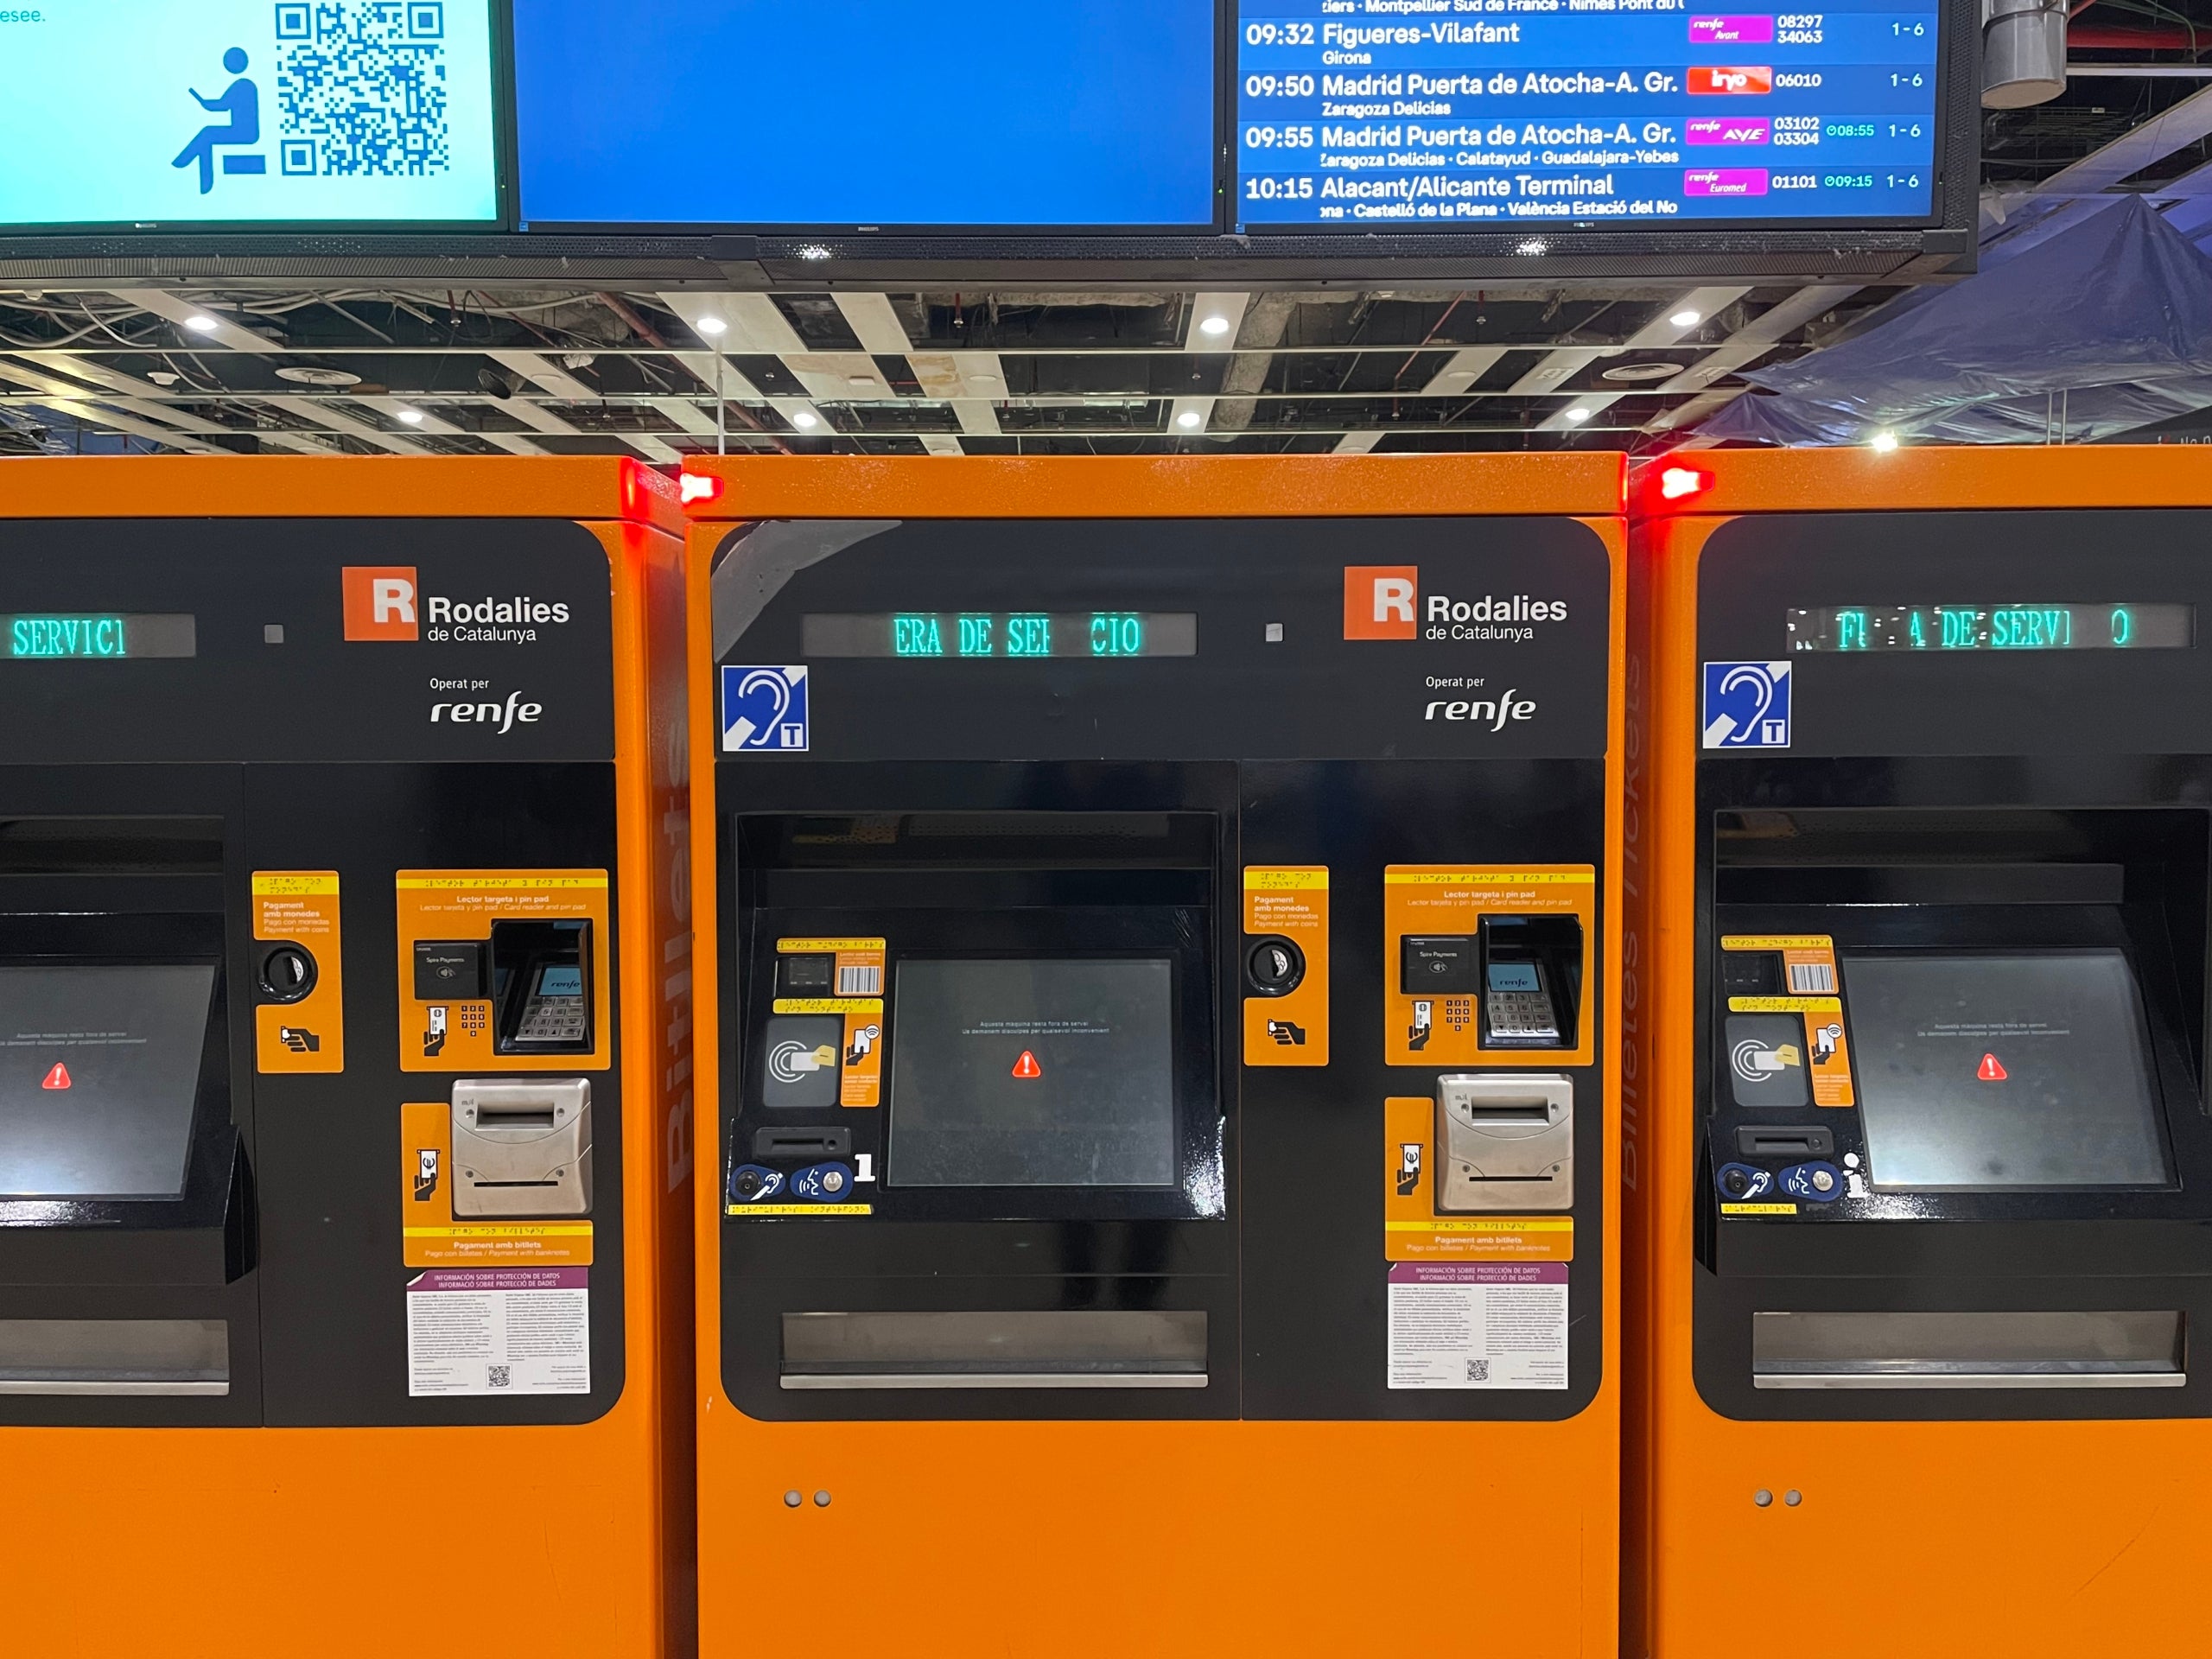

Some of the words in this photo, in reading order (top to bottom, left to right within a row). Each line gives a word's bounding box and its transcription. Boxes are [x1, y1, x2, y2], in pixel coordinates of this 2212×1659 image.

[1454, 0, 1483, 11] Sud
[1485, 0, 1505, 11] de
[1507, 0, 1558, 11] France
[1618, 0, 1654, 10] Pont
[1656, 0, 1675, 10] du
[1694, 18, 1724, 31] renfe
[1777, 15, 1823, 28] 08297
[1246, 23, 1314, 45] 09:32
[1323, 22, 1520, 49] Figueres-Vilafant
[1715, 31, 1739, 40] Avant
[1777, 30, 1823, 43] 34063
[1322, 51, 1372, 65] Girona
[1246, 75, 1314, 97] 09:50
[1322, 73, 1402, 96] Madrid
[1408, 73, 1483, 95] Puerta
[1488, 73, 1518, 94] de
[1522, 72, 1638, 93] Atocha-A.
[1643, 72, 1678, 93] Gr.
[1776, 73, 1821, 87] 06010
[1322, 102, 1390, 118] Zaragoza
[1393, 101, 1452, 115] Delicias
[1690, 120, 1721, 133] renfe
[1774, 117, 1820, 130] 03102
[1246, 127, 1313, 148] 09:55
[1322, 125, 1401, 147] Madrid
[1407, 125, 1481, 146] Puerta
[1486, 124, 1516, 145] de
[1521, 124, 1637, 144] Atocha-A.
[1643, 123, 1676, 143] Gr.
[1723, 129, 1765, 142] AVE
[1838, 124, 1874, 137] 08:55
[1774, 132, 1820, 145] 03304
[1388, 152, 1446, 167] Delicias
[1456, 150, 1530, 168] Calatayud
[1541, 149, 1679, 167] Guadalajara-Yebes
[1688, 172, 1719, 184] renfe
[1772, 175, 1817, 188] 01101
[1835, 175, 1872, 188] 09:15
[1246, 178, 1313, 199] 10:15
[1320, 175, 1511, 201] Alacant/Alicante
[1516, 175, 1614, 195] Terminal
[1710, 183, 1746, 193] Euromed
[1353, 203, 1414, 217] Castelló
[1418, 203, 1437, 216] de
[1440, 203, 1454, 216] la
[1456, 202, 1497, 215] Plana
[1507, 200, 1570, 216] València
[1573, 200, 1627, 215] Estació
[1630, 200, 1654, 214] del
[1656, 200, 1678, 214] No
[373, 579, 416, 623] R
[1374, 578, 1414, 622] R
[428, 597, 570, 623] Rodalies
[1427, 595, 1568, 622] Rodalies
[428, 626, 448, 641] de
[454, 626, 537, 645] Catalunya
[959, 619, 992, 653] DE
[1426, 626, 1446, 640] de
[1452, 625, 1534, 643] Catalunya
[429, 678, 467, 690] Operat
[472, 679, 489, 691] per
[1426, 677, 1463, 690] Operat
[1467, 678, 1484, 689] per
[430, 691, 543, 734] renfe
[1425, 689, 1536, 732] renfe
[785, 726, 802, 745] T
[1765, 722, 1782, 741] T
[485, 896, 513, 905] targeta
[519, 895, 531, 904] pin
[533, 895, 550, 904] pad
[1255, 896, 1294, 905] Pagament
[1506, 891, 1518, 899] pin
[1521, 891, 1535, 899] pad
[263, 901, 304, 910] Pagament
[551, 980, 580, 988] renfe
[454, 1242, 493, 1250] Pagament
[1435, 1236, 1474, 1245] Pagament
[1469, 1243, 1499, 1252] Payment
